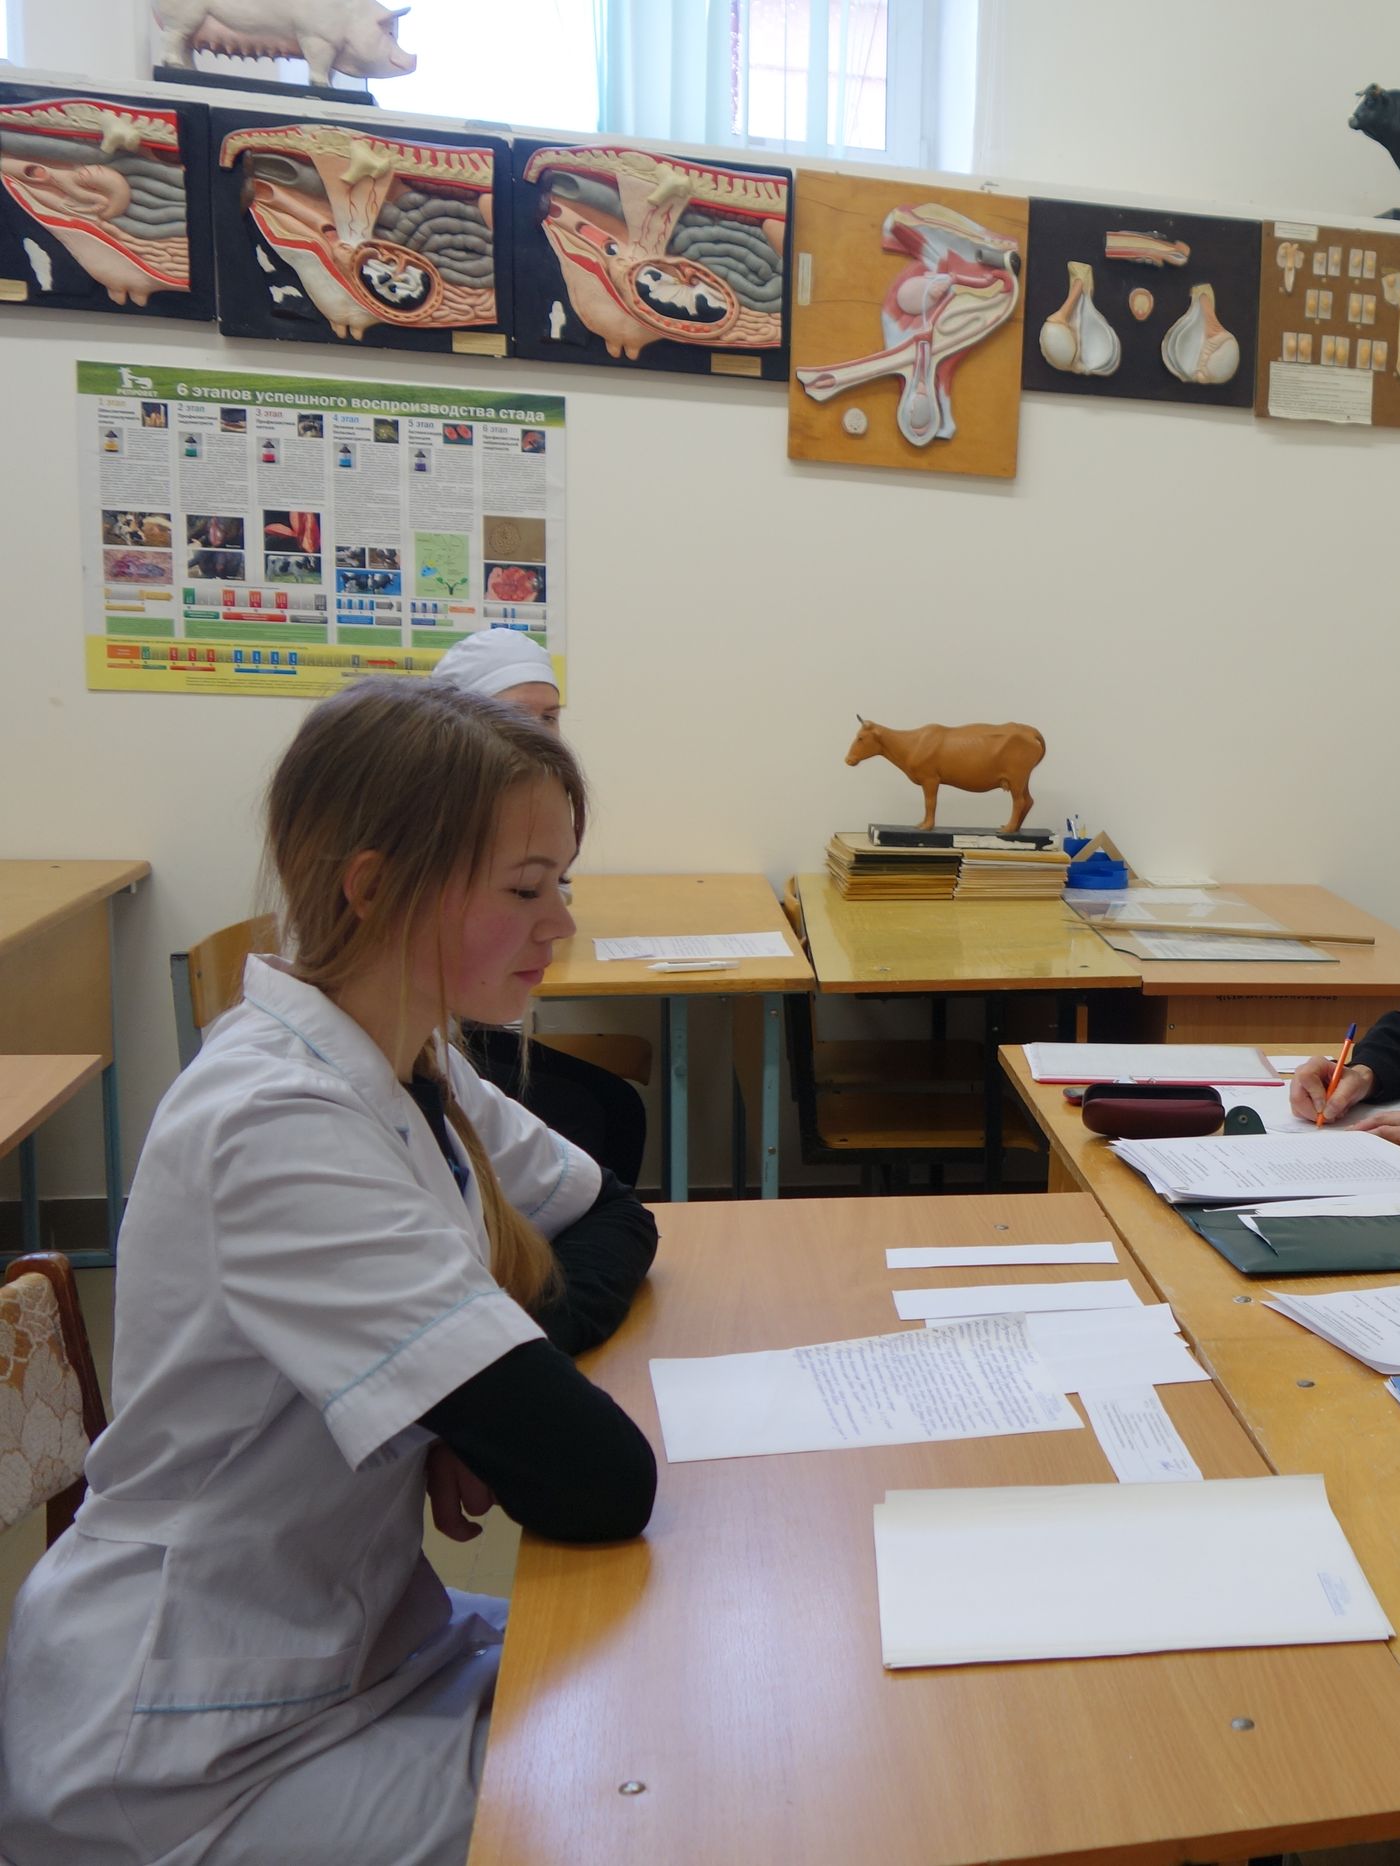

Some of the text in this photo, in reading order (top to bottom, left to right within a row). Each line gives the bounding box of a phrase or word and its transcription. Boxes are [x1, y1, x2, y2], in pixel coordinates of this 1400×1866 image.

[176, 383, 545, 422] 6 этапов успешного воспроизводства стада
[186, 405, 205, 413] этап
[341, 416, 359, 424] этап
[416, 421, 434, 429] этап
